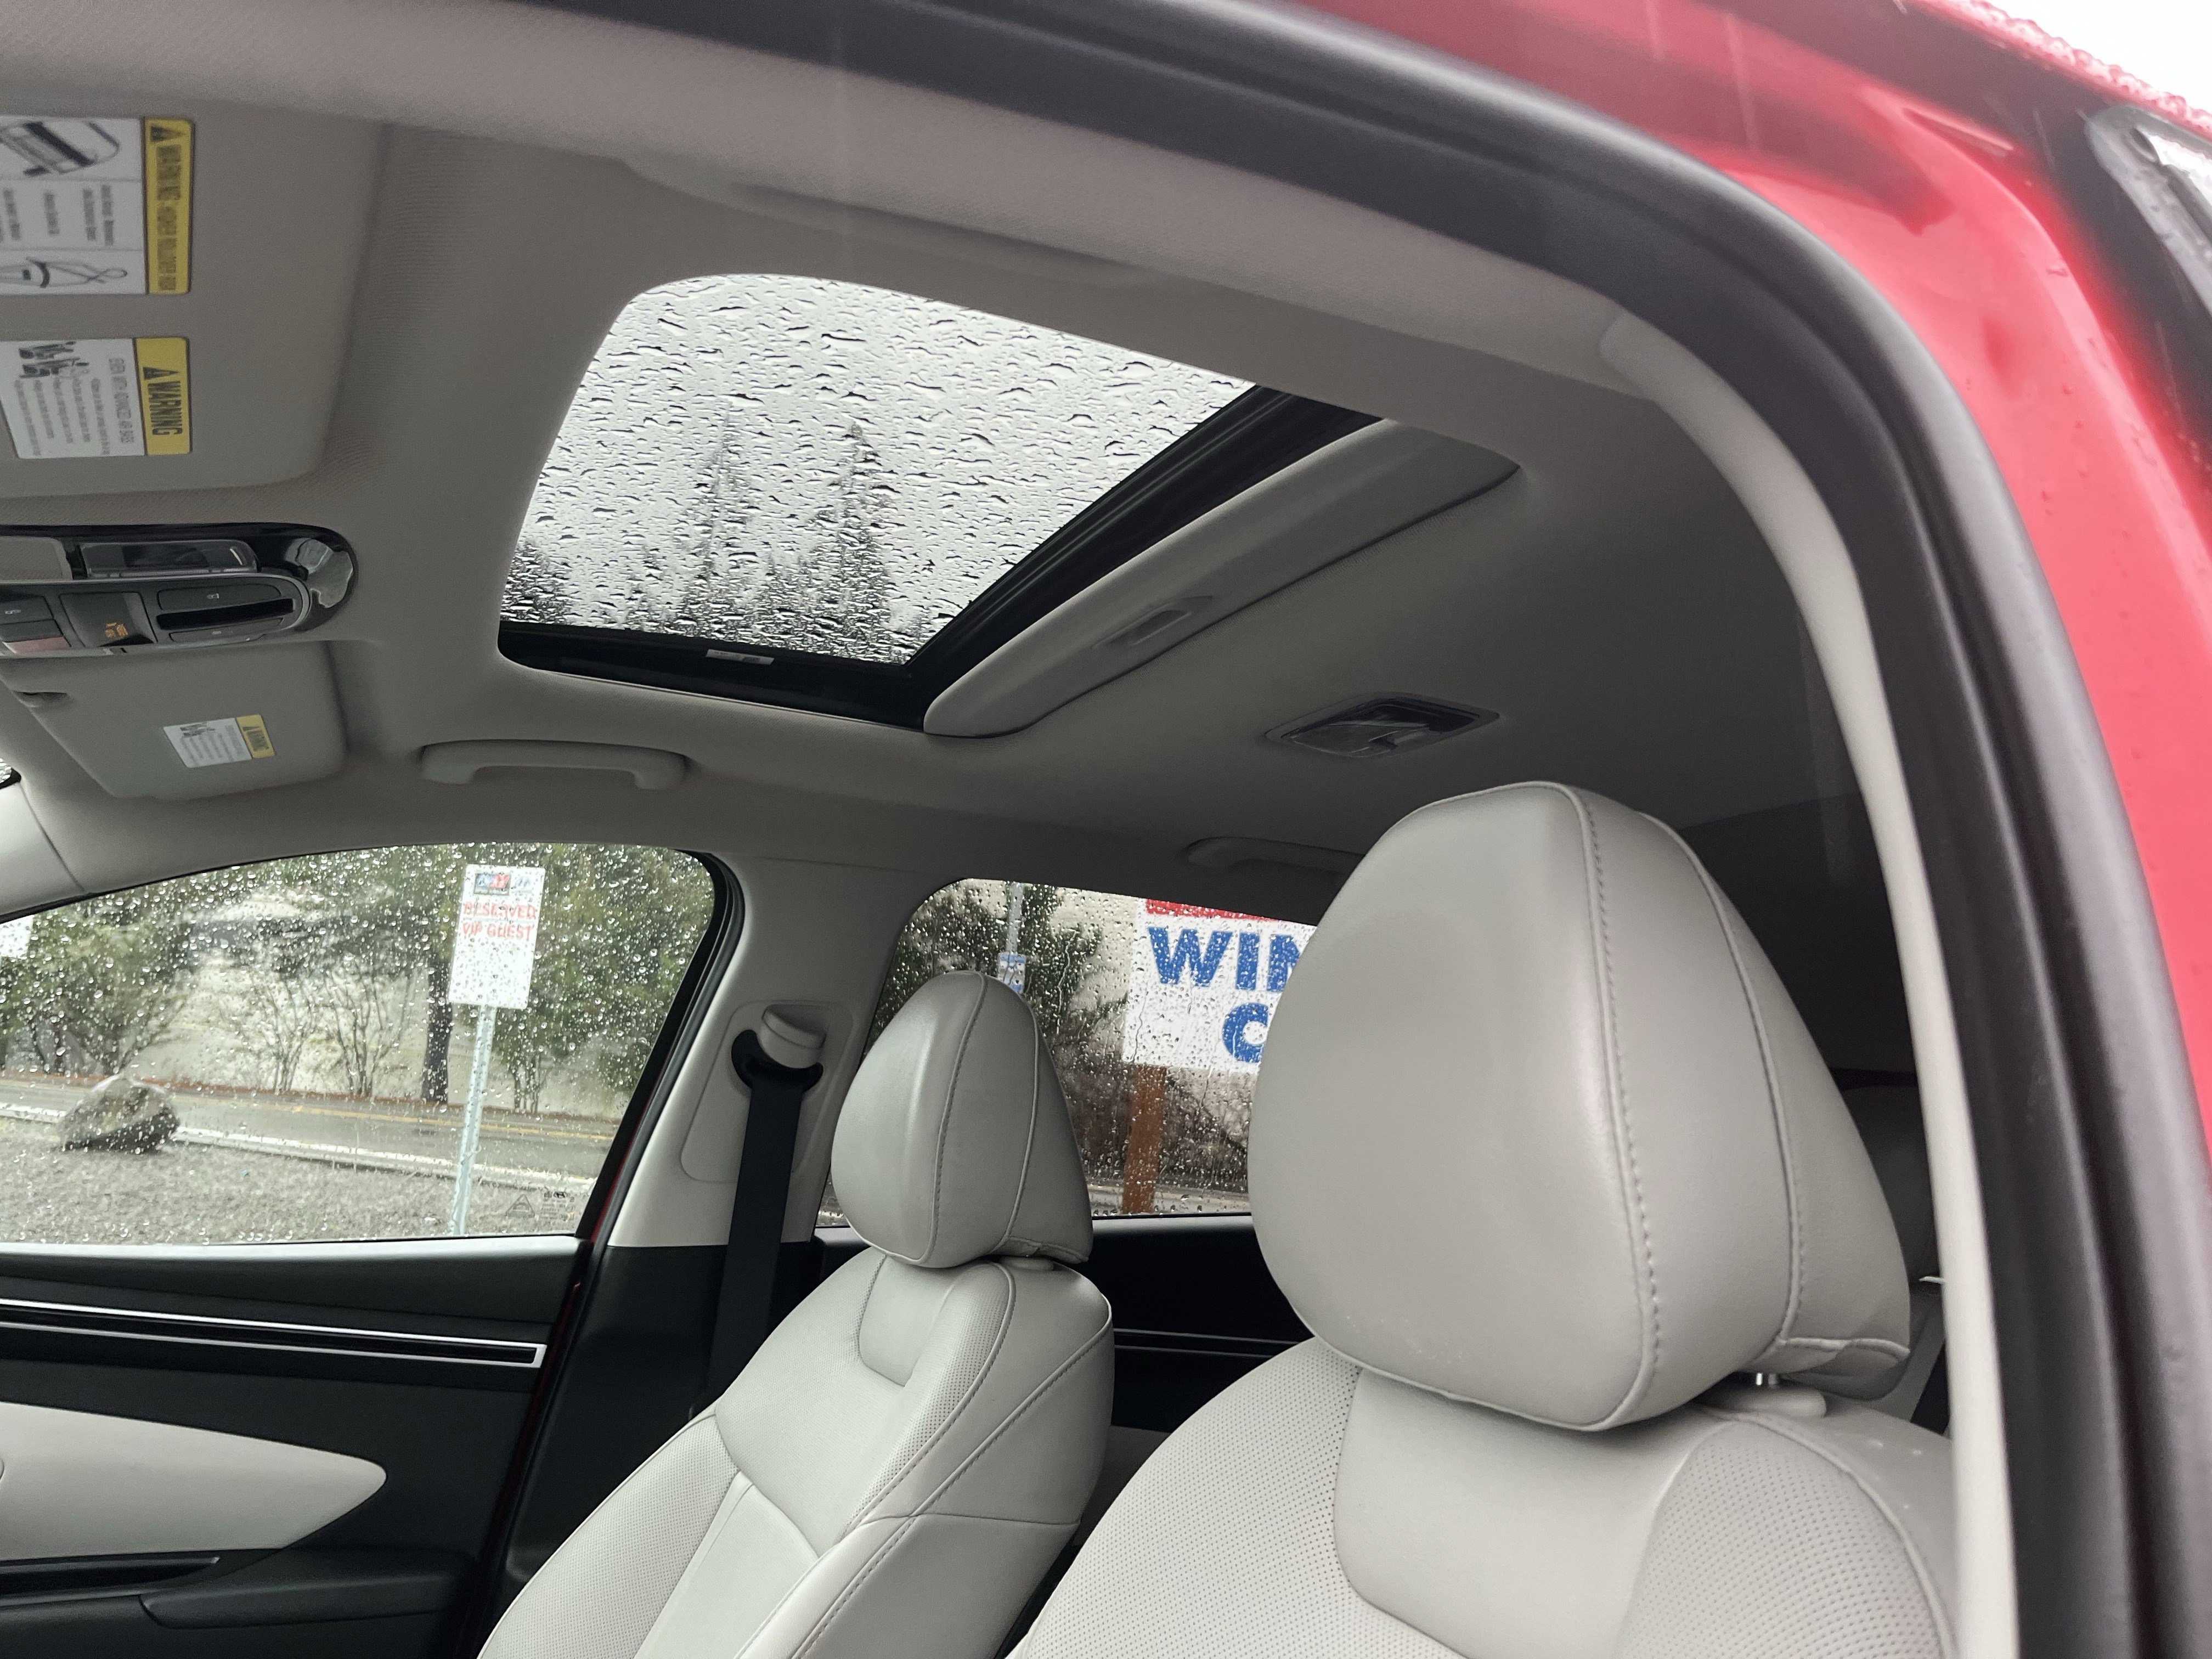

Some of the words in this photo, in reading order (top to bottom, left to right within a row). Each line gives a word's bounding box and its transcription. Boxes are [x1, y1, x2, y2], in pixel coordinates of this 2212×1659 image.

[148, 381, 183, 436] WARNING
[463, 901, 537, 919] RESERVED
[487, 924, 534, 941] GUEST
